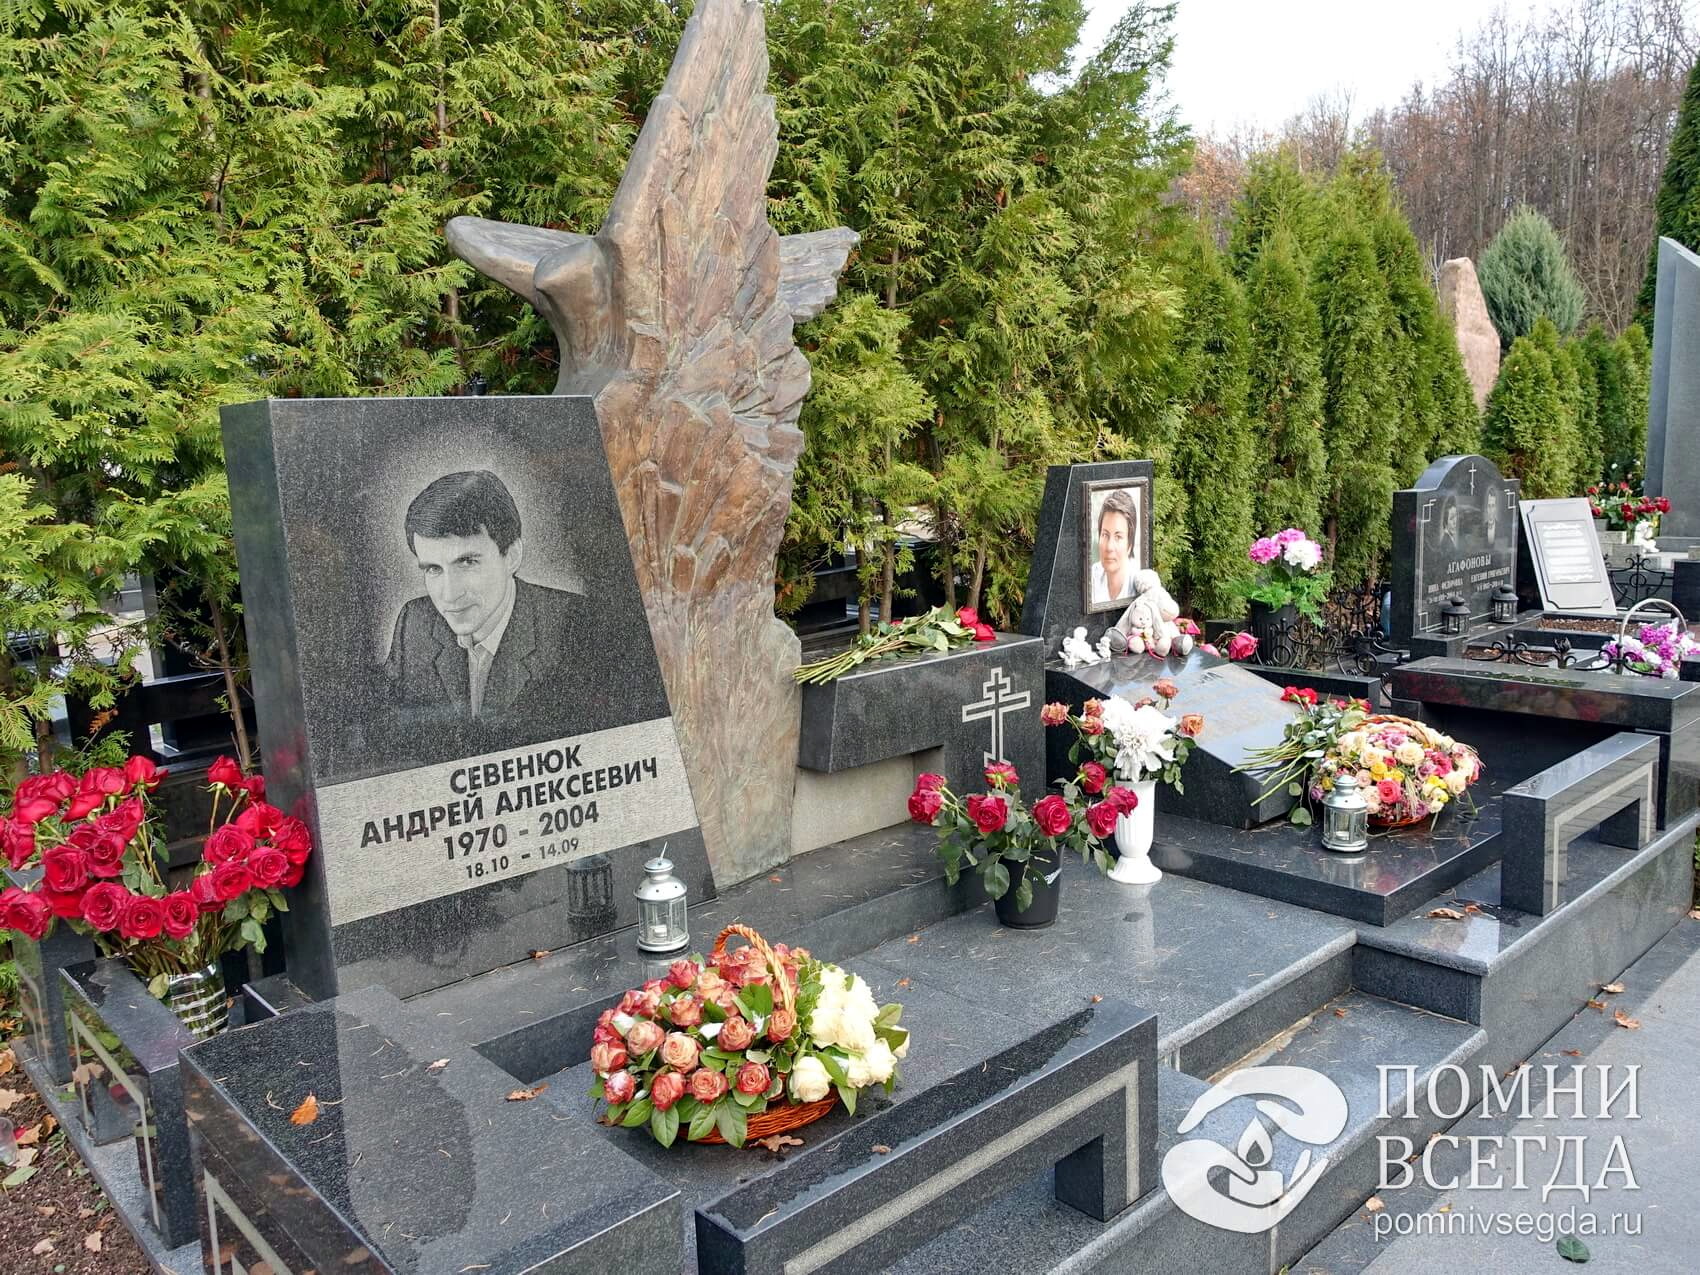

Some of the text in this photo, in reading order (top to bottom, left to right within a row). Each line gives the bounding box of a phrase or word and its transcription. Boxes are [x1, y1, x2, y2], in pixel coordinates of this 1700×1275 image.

[1447, 554, 1492, 574] АГАФОНОВЫ
[450, 744, 582, 794] СЕВЕНЮК
[360, 757, 658, 848] АНДРЕЙ АЛЕКСЕЕВИЧ
[443, 824, 508, 860] 1970
[538, 800, 599, 837] 2004
[466, 856, 509, 879] 18.10
[539, 838, 579, 860] 14.09
